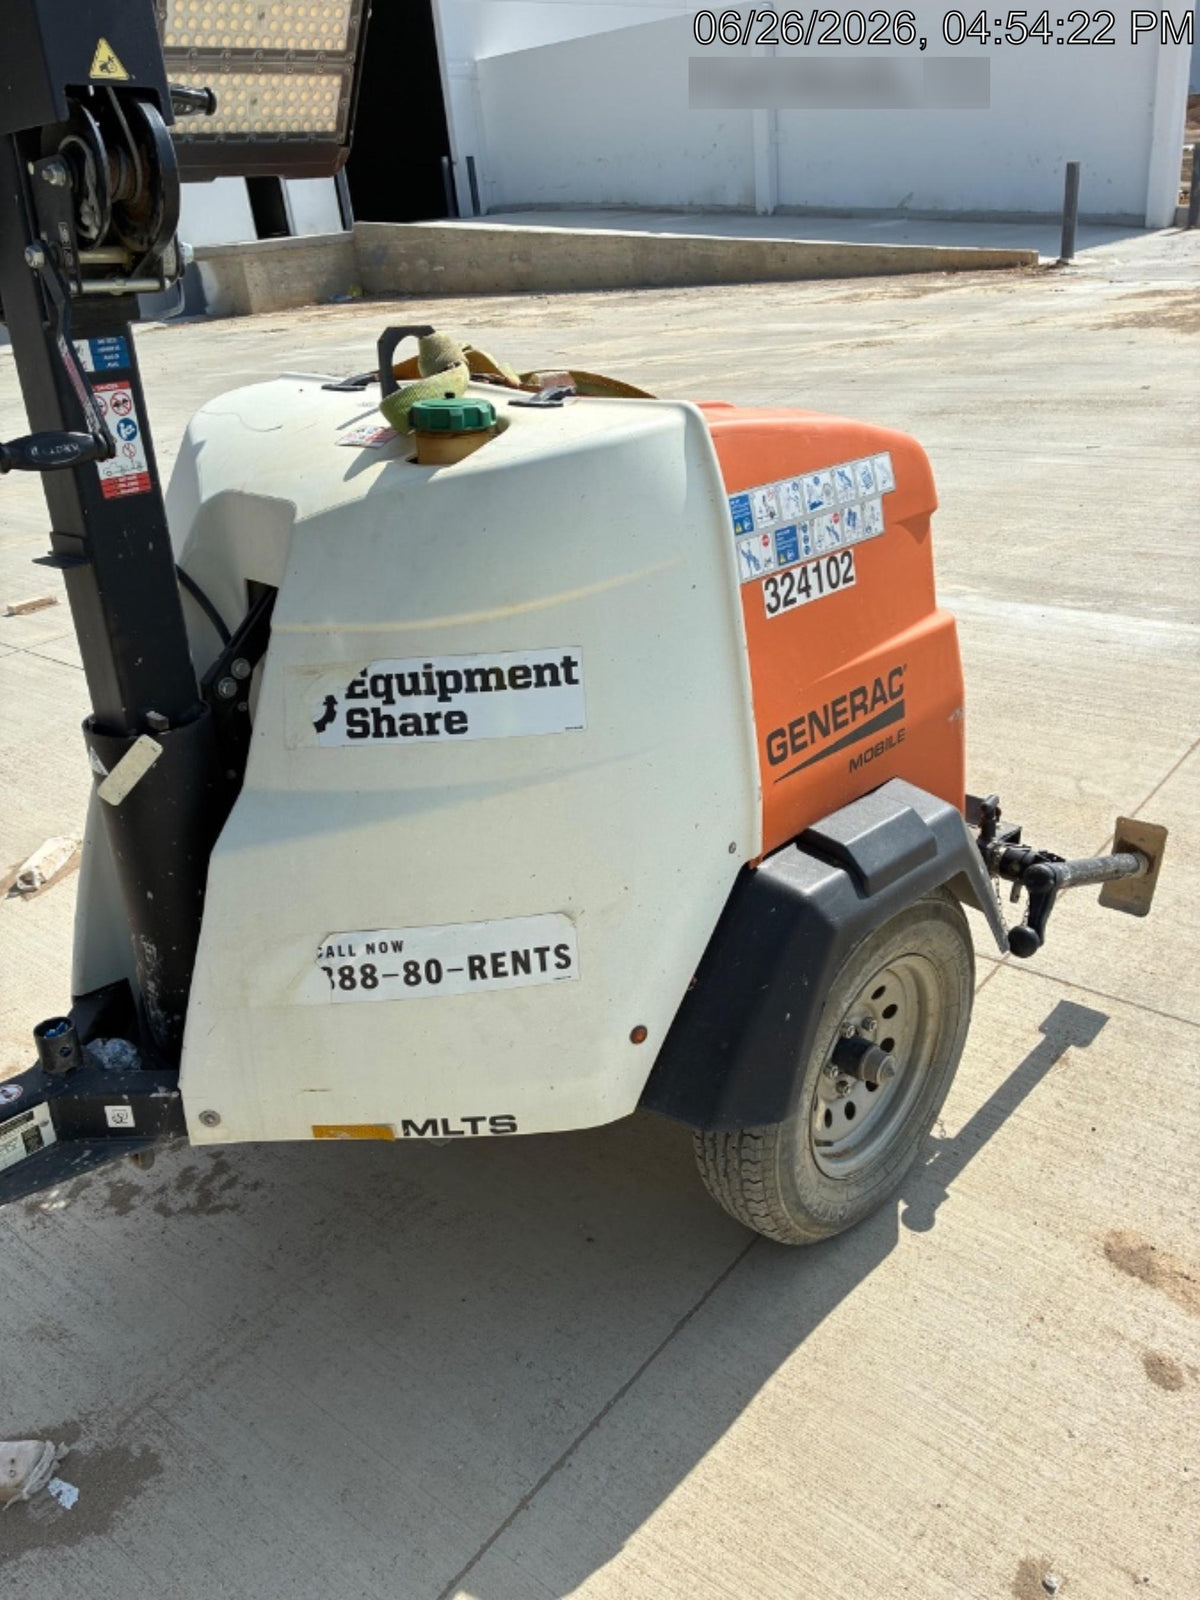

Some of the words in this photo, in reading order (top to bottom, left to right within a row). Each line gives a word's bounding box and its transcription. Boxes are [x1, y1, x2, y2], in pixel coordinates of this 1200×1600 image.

[764, 550, 854, 614] 324102
[345, 656, 579, 704] Equipment
[346, 706, 468, 738] Share
[766, 666, 904, 766] GENERAC
[849, 728, 905, 773] MOBILE
[365, 940, 404, 955] NOW
[401, 1115, 518, 1136] MLTS
